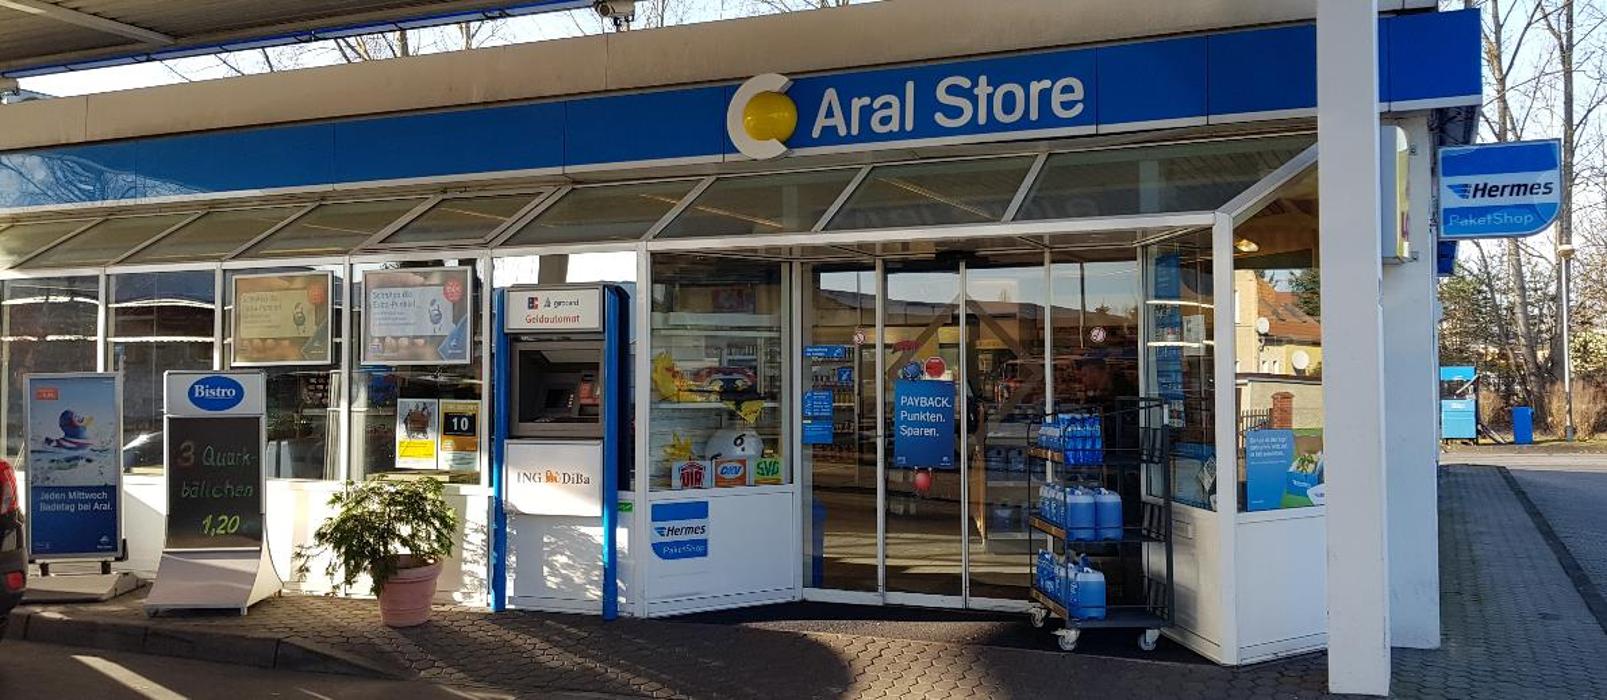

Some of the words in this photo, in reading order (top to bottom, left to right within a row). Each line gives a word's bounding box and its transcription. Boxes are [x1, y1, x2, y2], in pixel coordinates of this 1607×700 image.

[811, 81, 914, 139] Aral
[933, 75, 1085, 128] Store
[1472, 181, 1553, 199] Hermes
[1449, 212, 1535, 226] PaketShop
[525, 314, 580, 324] Geldautomat
[194, 384, 236, 398] Bistro
[900, 395, 952, 408] PAYBACK.
[900, 410, 946, 423] Punkten.
[452, 417, 469, 431] 10
[899, 425, 940, 437] Sparen.
[177, 440, 195, 466] 3
[517, 471, 542, 484] ING
[561, 471, 591, 485] DiBa
[40, 491, 66, 500] Jeden
[68, 490, 108, 500] Mittwoch
[40, 502, 75, 512] Badetag
[77, 501, 91, 511] bei
[92, 501, 113, 511] Aral.
[202, 514, 240, 537] 1,20
[665, 524, 706, 537] Hermes
[663, 543, 706, 554] PaketShop
